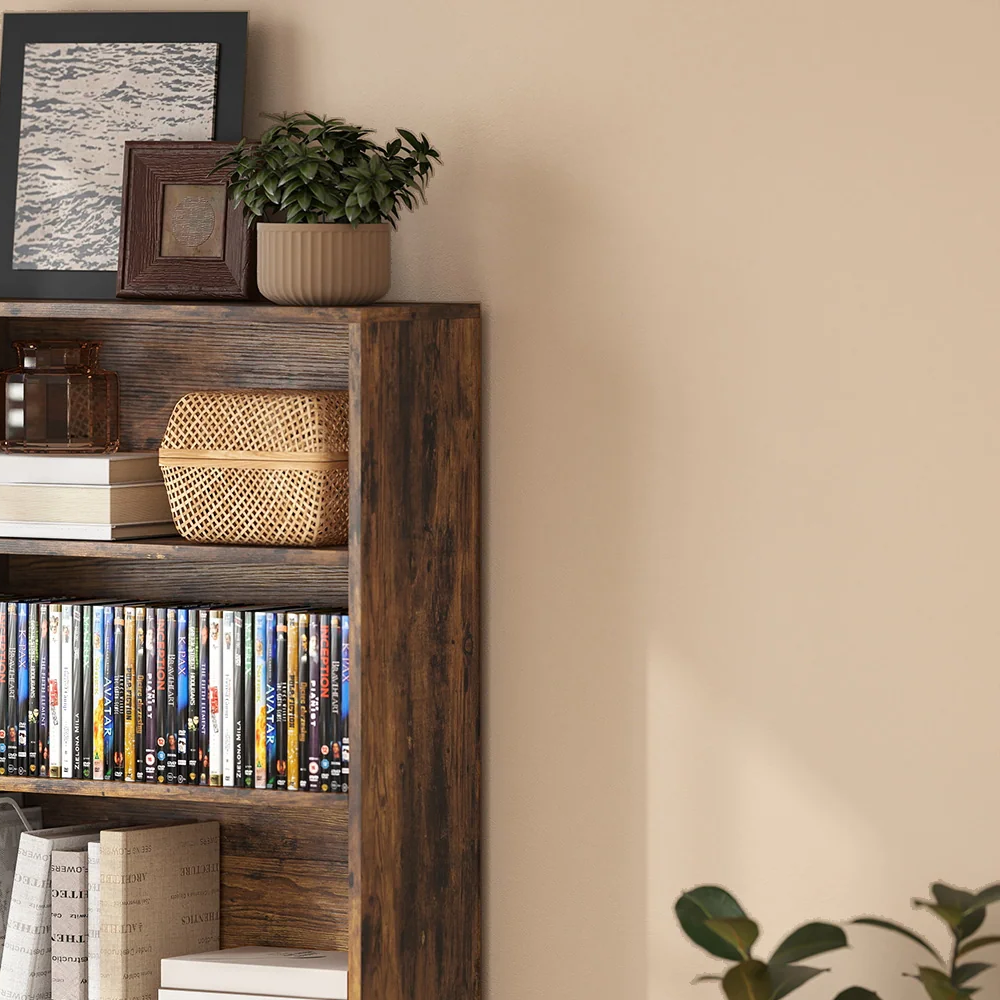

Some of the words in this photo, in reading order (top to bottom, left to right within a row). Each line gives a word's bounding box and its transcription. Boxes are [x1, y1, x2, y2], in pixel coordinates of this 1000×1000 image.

[157, 618, 165, 690] INCEPTION
[320, 625, 329, 698] INCEPTION
[104, 677, 112, 737] AVATAR
[266, 684, 274, 745] AVATAR
